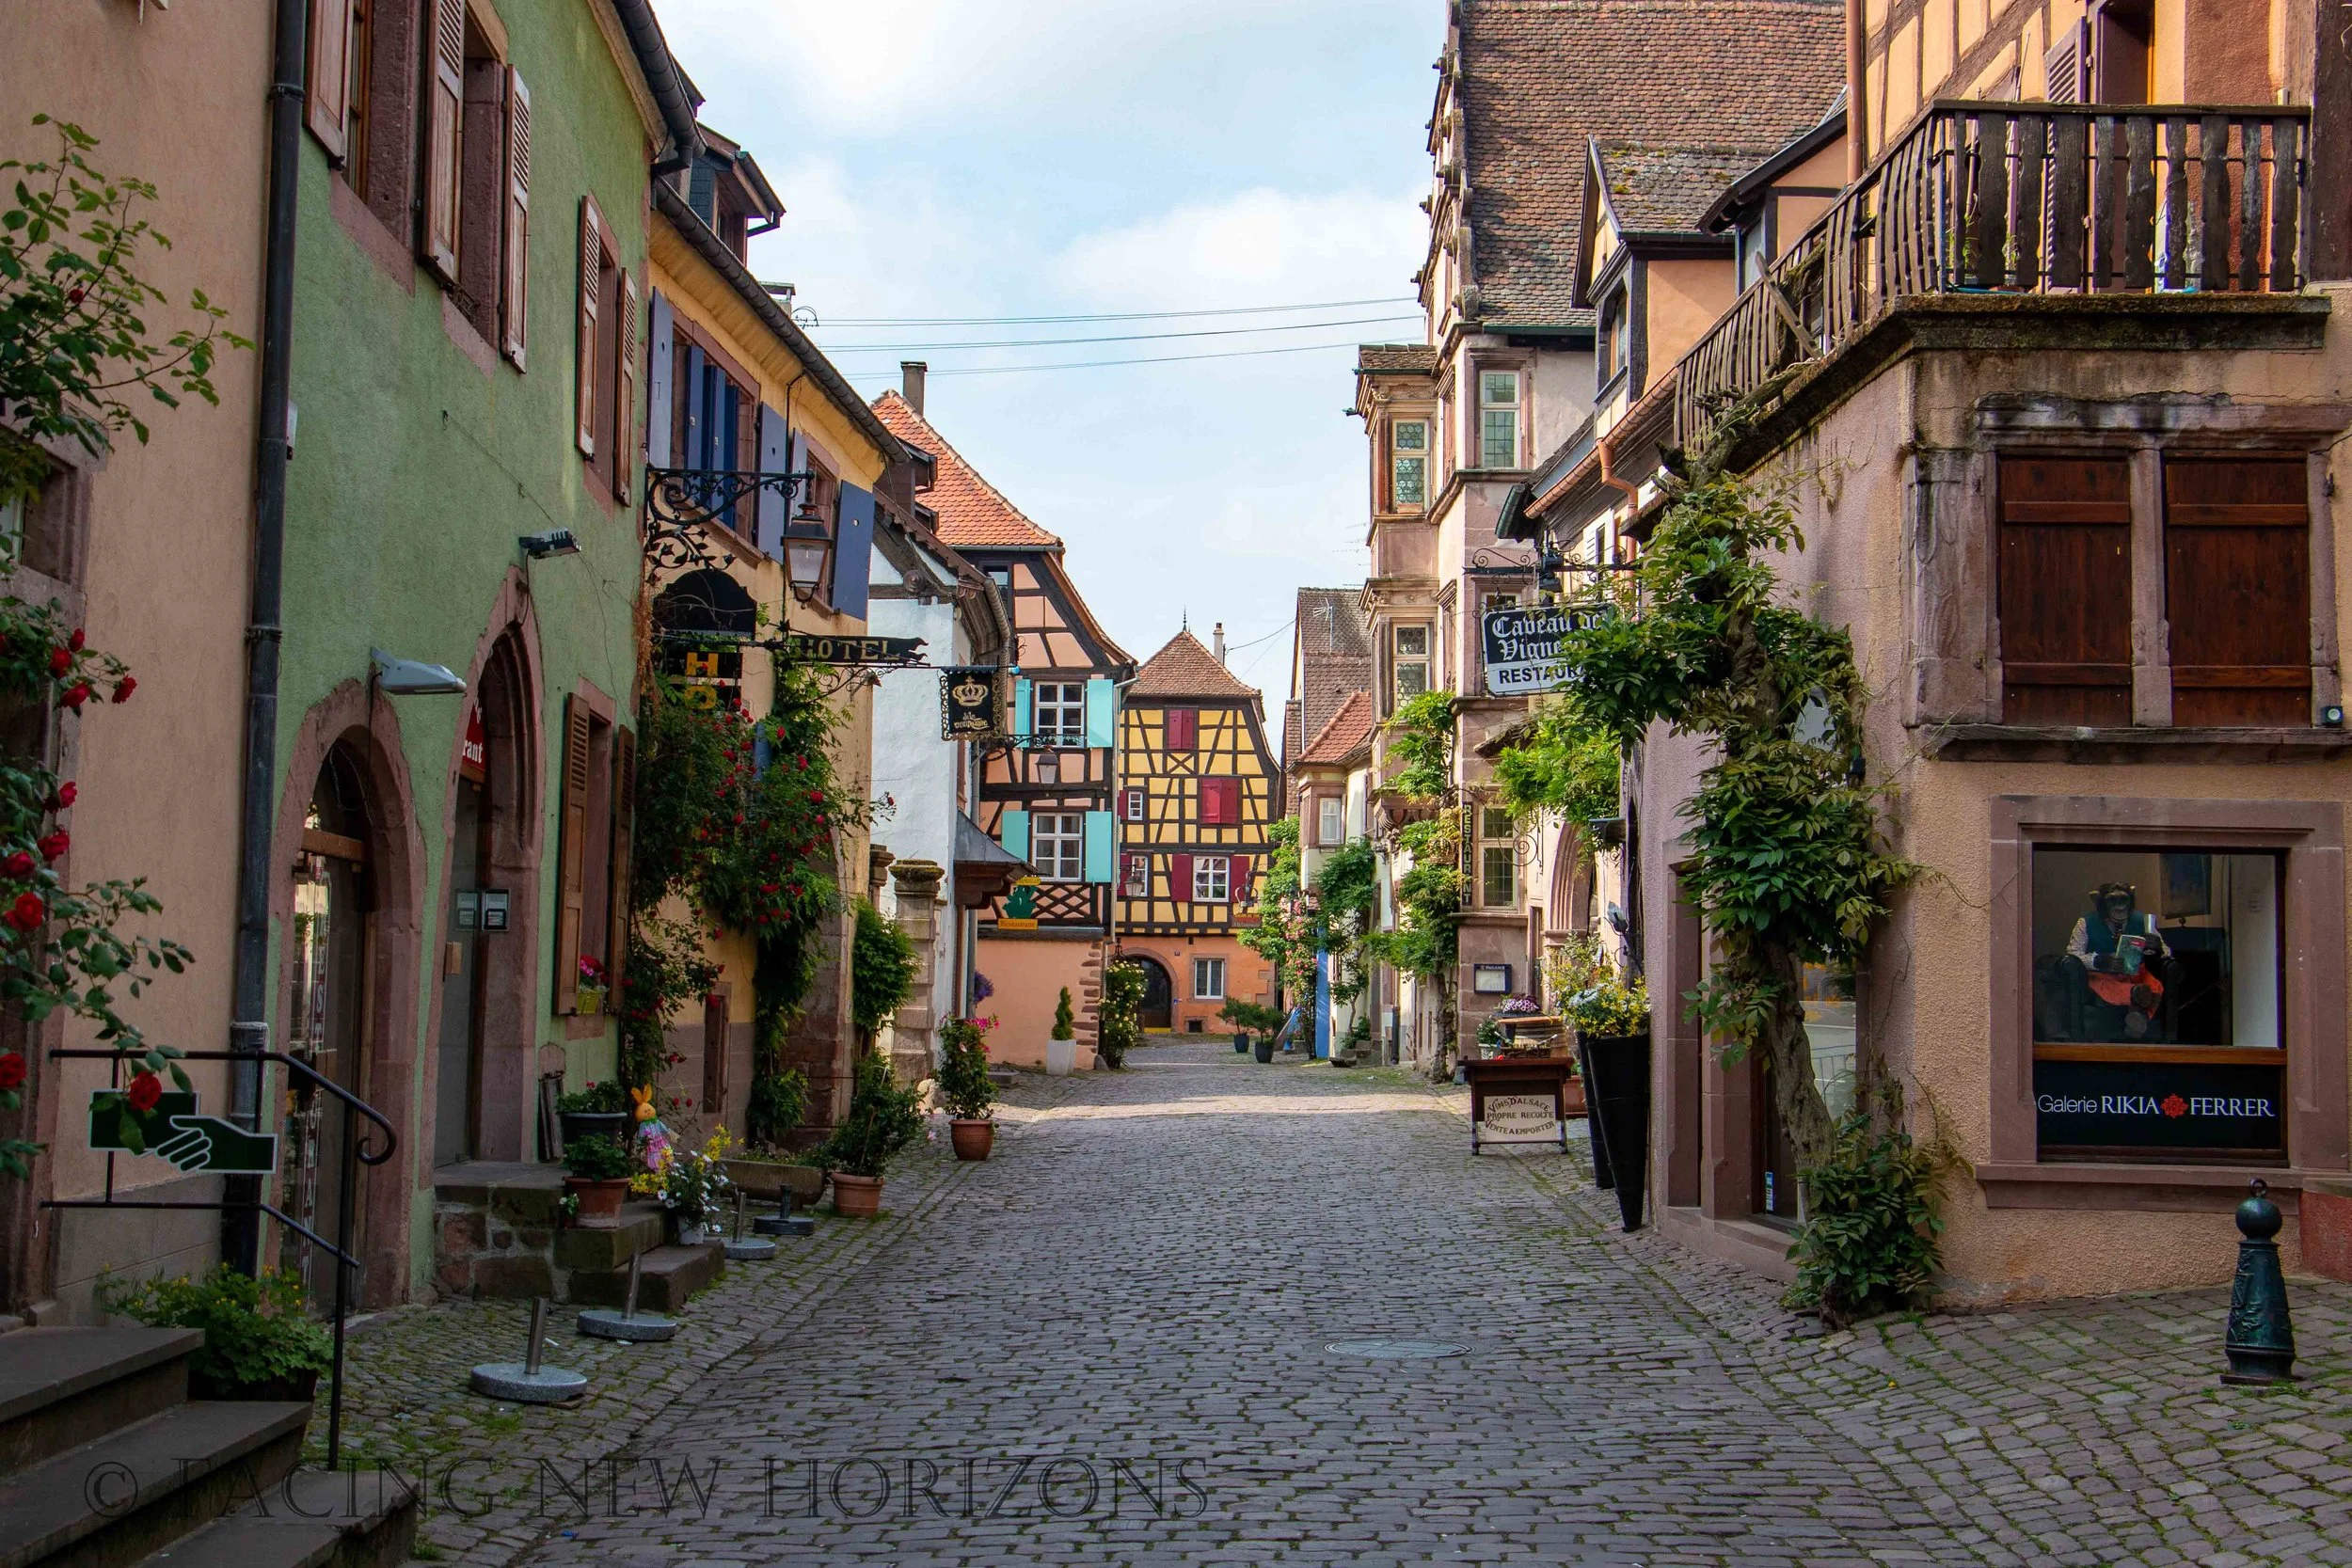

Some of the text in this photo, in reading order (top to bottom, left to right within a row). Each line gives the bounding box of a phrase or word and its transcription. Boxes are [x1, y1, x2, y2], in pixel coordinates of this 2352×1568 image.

[1492, 616, 1573, 639] Caveau
[1498, 639, 1578, 661] Vigne
[1499, 663, 1585, 685] RESTAUR
[1463, 804, 1473, 904] RESTAURNT
[1486, 1112, 1518, 1120] PROPRE
[2037, 1094, 2275, 1117] Galerie RIKIA FERRER
[1516, 1120, 1555, 1135] EMPORTER
